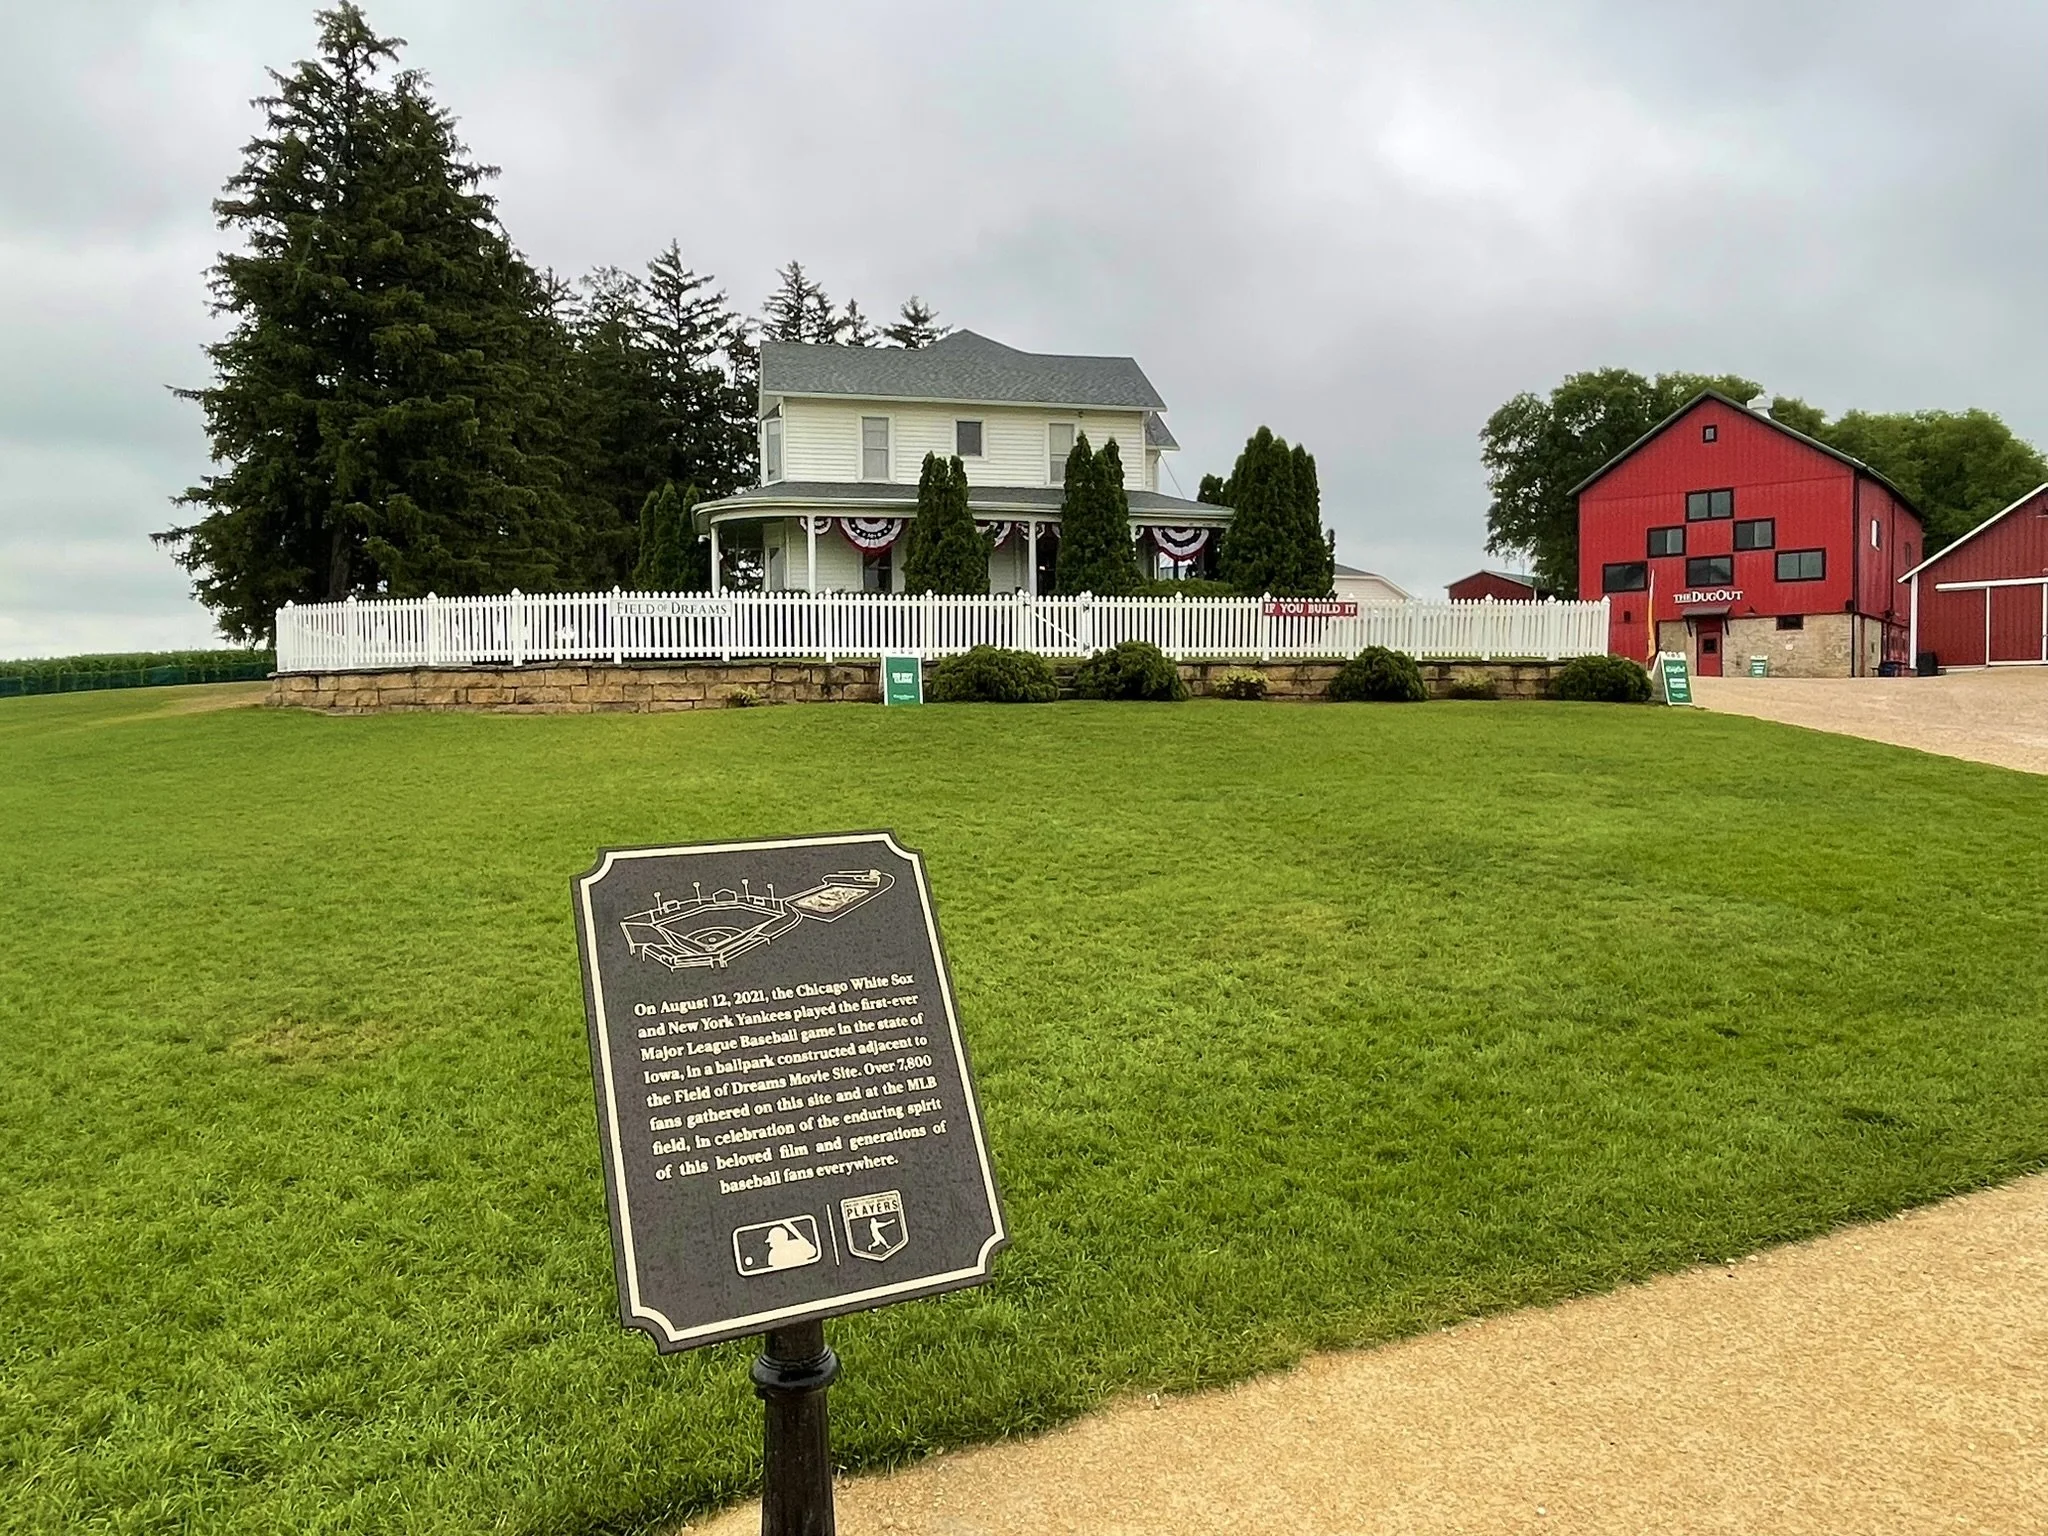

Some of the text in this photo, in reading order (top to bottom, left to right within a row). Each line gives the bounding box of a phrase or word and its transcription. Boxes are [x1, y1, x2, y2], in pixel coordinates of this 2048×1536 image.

[617, 602, 655, 615] FIELD
[671, 601, 727, 615] DREAMS
[1265, 603, 1356, 613] IF YOU BUILD IT
[634, 973, 914, 1016] On August 12, 2021, the Chicago White Sox
[637, 994, 919, 1038] and New York Yankees played the first-ever
[640, 1012, 924, 1062] Major League Baseball game in the state of
[643, 1035, 927, 1084] Iowa, in a ballpark constructed adjacent to
[646, 1054, 932, 1107] the Field of Dreams Movie Site. Over 7,800
[649, 1075, 937, 1131] fans gathered on this site and at the MLB
[652, 1097, 942, 1155] field, in celebration of the enduring spirit
[655, 1119, 947, 1180] of this beloved film and generations of
[719, 1154, 899, 1194] baseball fans everywhere.
[846, 1200, 898, 1218] PLAYERS
